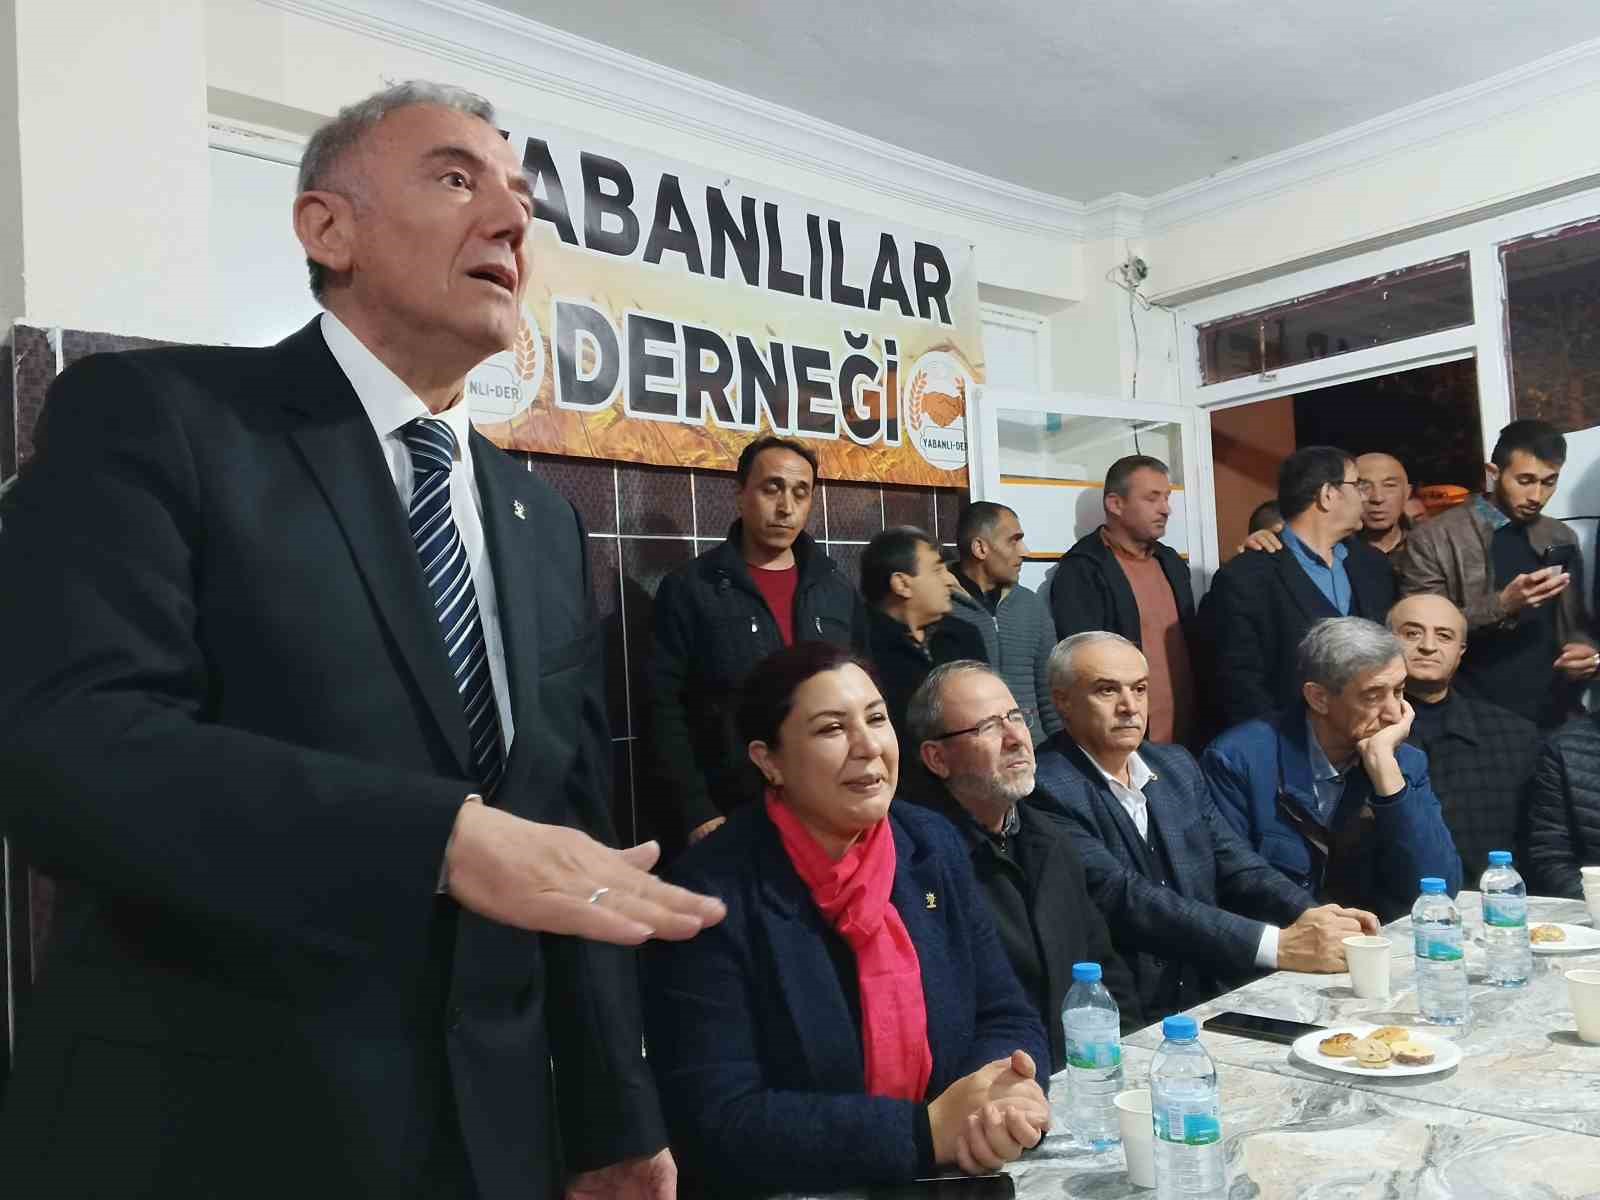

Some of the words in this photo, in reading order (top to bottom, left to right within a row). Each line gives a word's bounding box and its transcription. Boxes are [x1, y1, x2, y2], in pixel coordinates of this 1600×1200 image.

[497, 128, 952, 325] ABANLILAR
[468, 380, 519, 400] NLI-DER
[555, 301, 900, 442] DERNEĞİ
